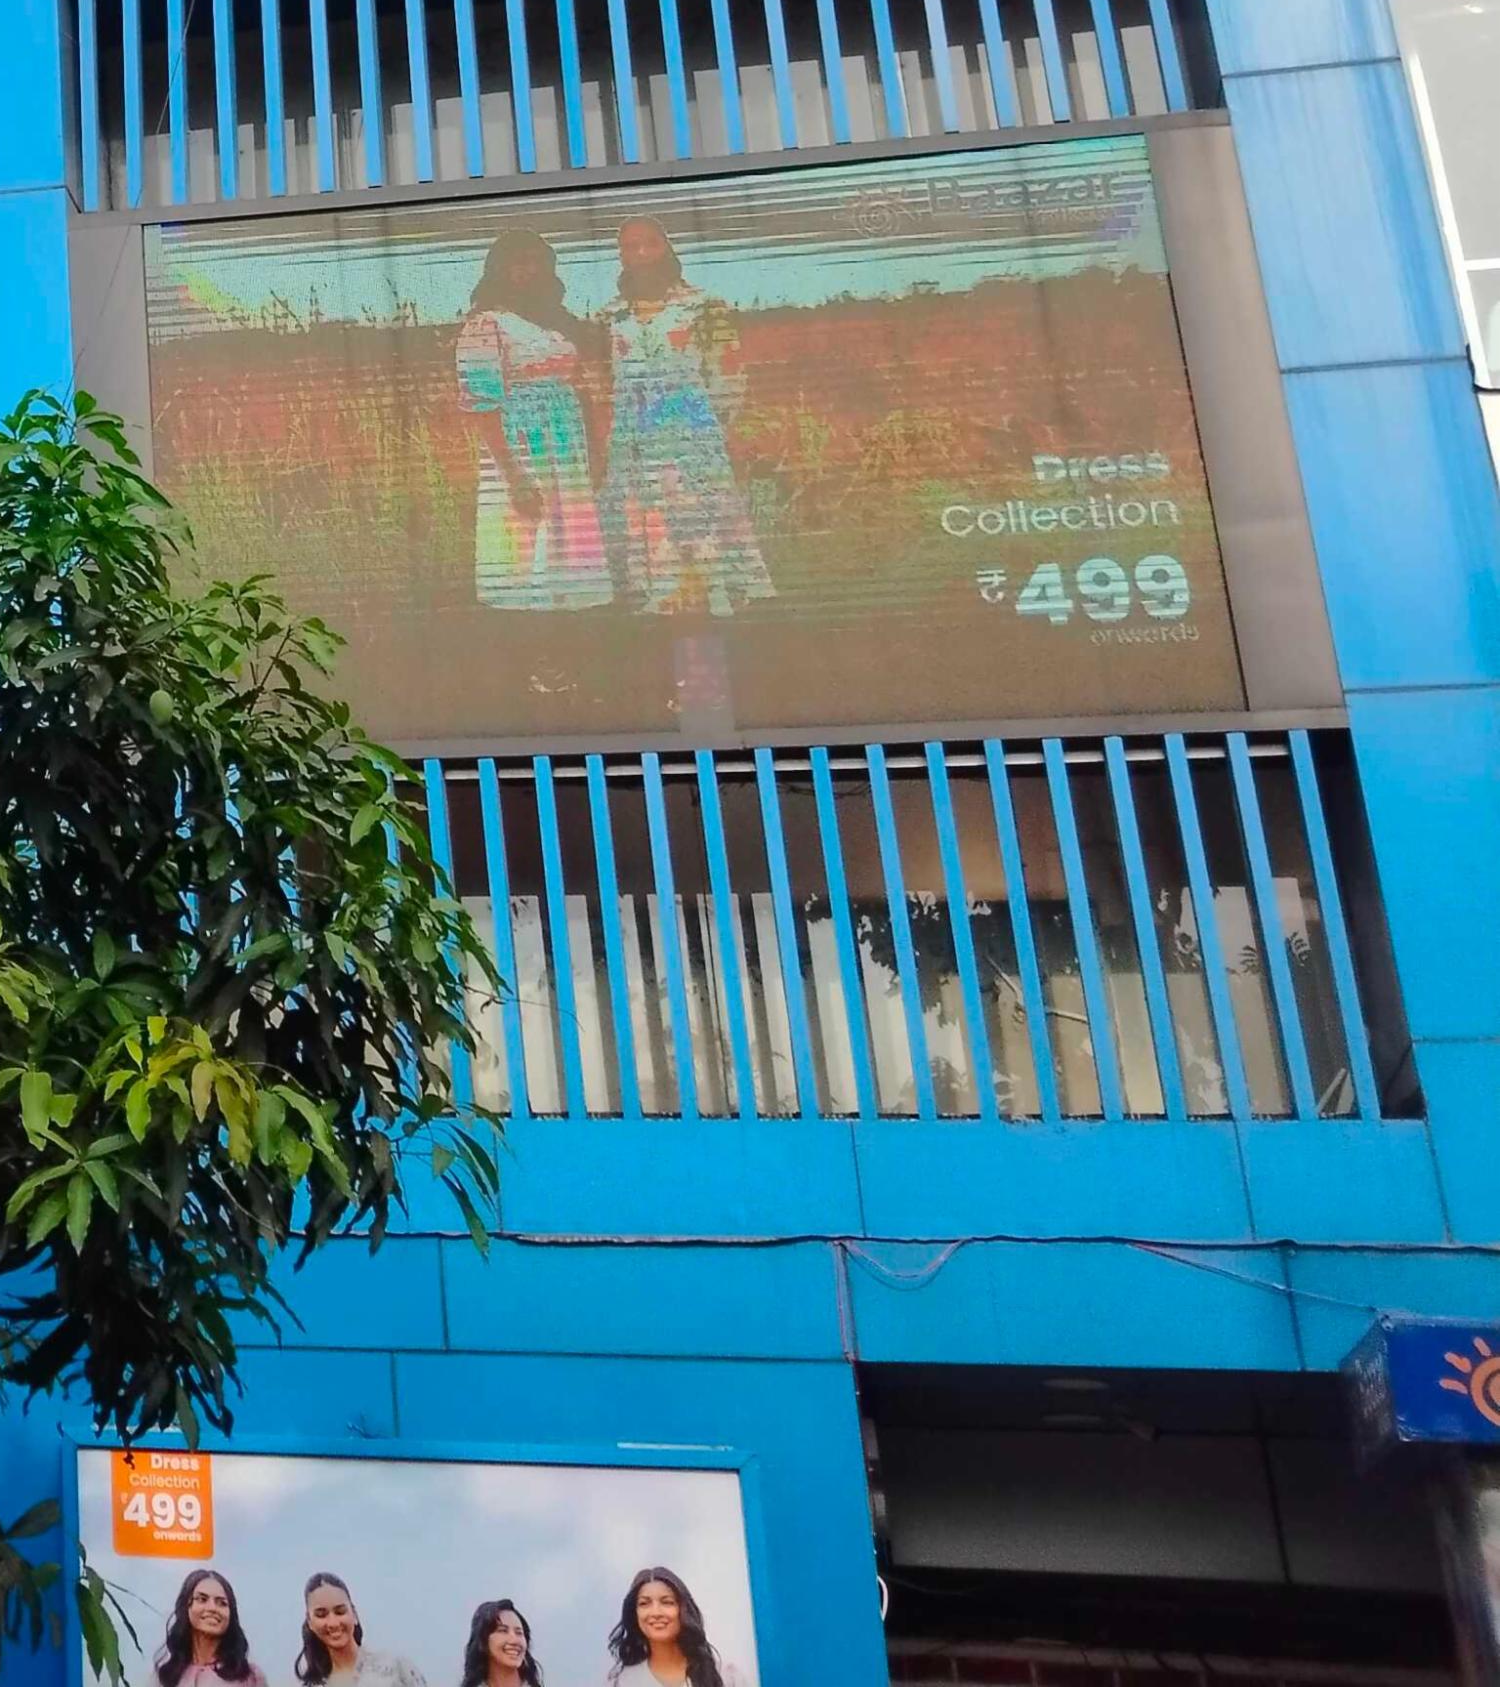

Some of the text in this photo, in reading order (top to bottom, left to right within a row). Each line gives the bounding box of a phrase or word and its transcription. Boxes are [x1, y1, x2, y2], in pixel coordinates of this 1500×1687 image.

[1032, 450, 1171, 484] Dress
[941, 493, 1182, 537] Collection
[151, 1454, 200, 1471] Dress
[129, 1473, 200, 1489] Collection
[153, 1530, 203, 1543] onwards
